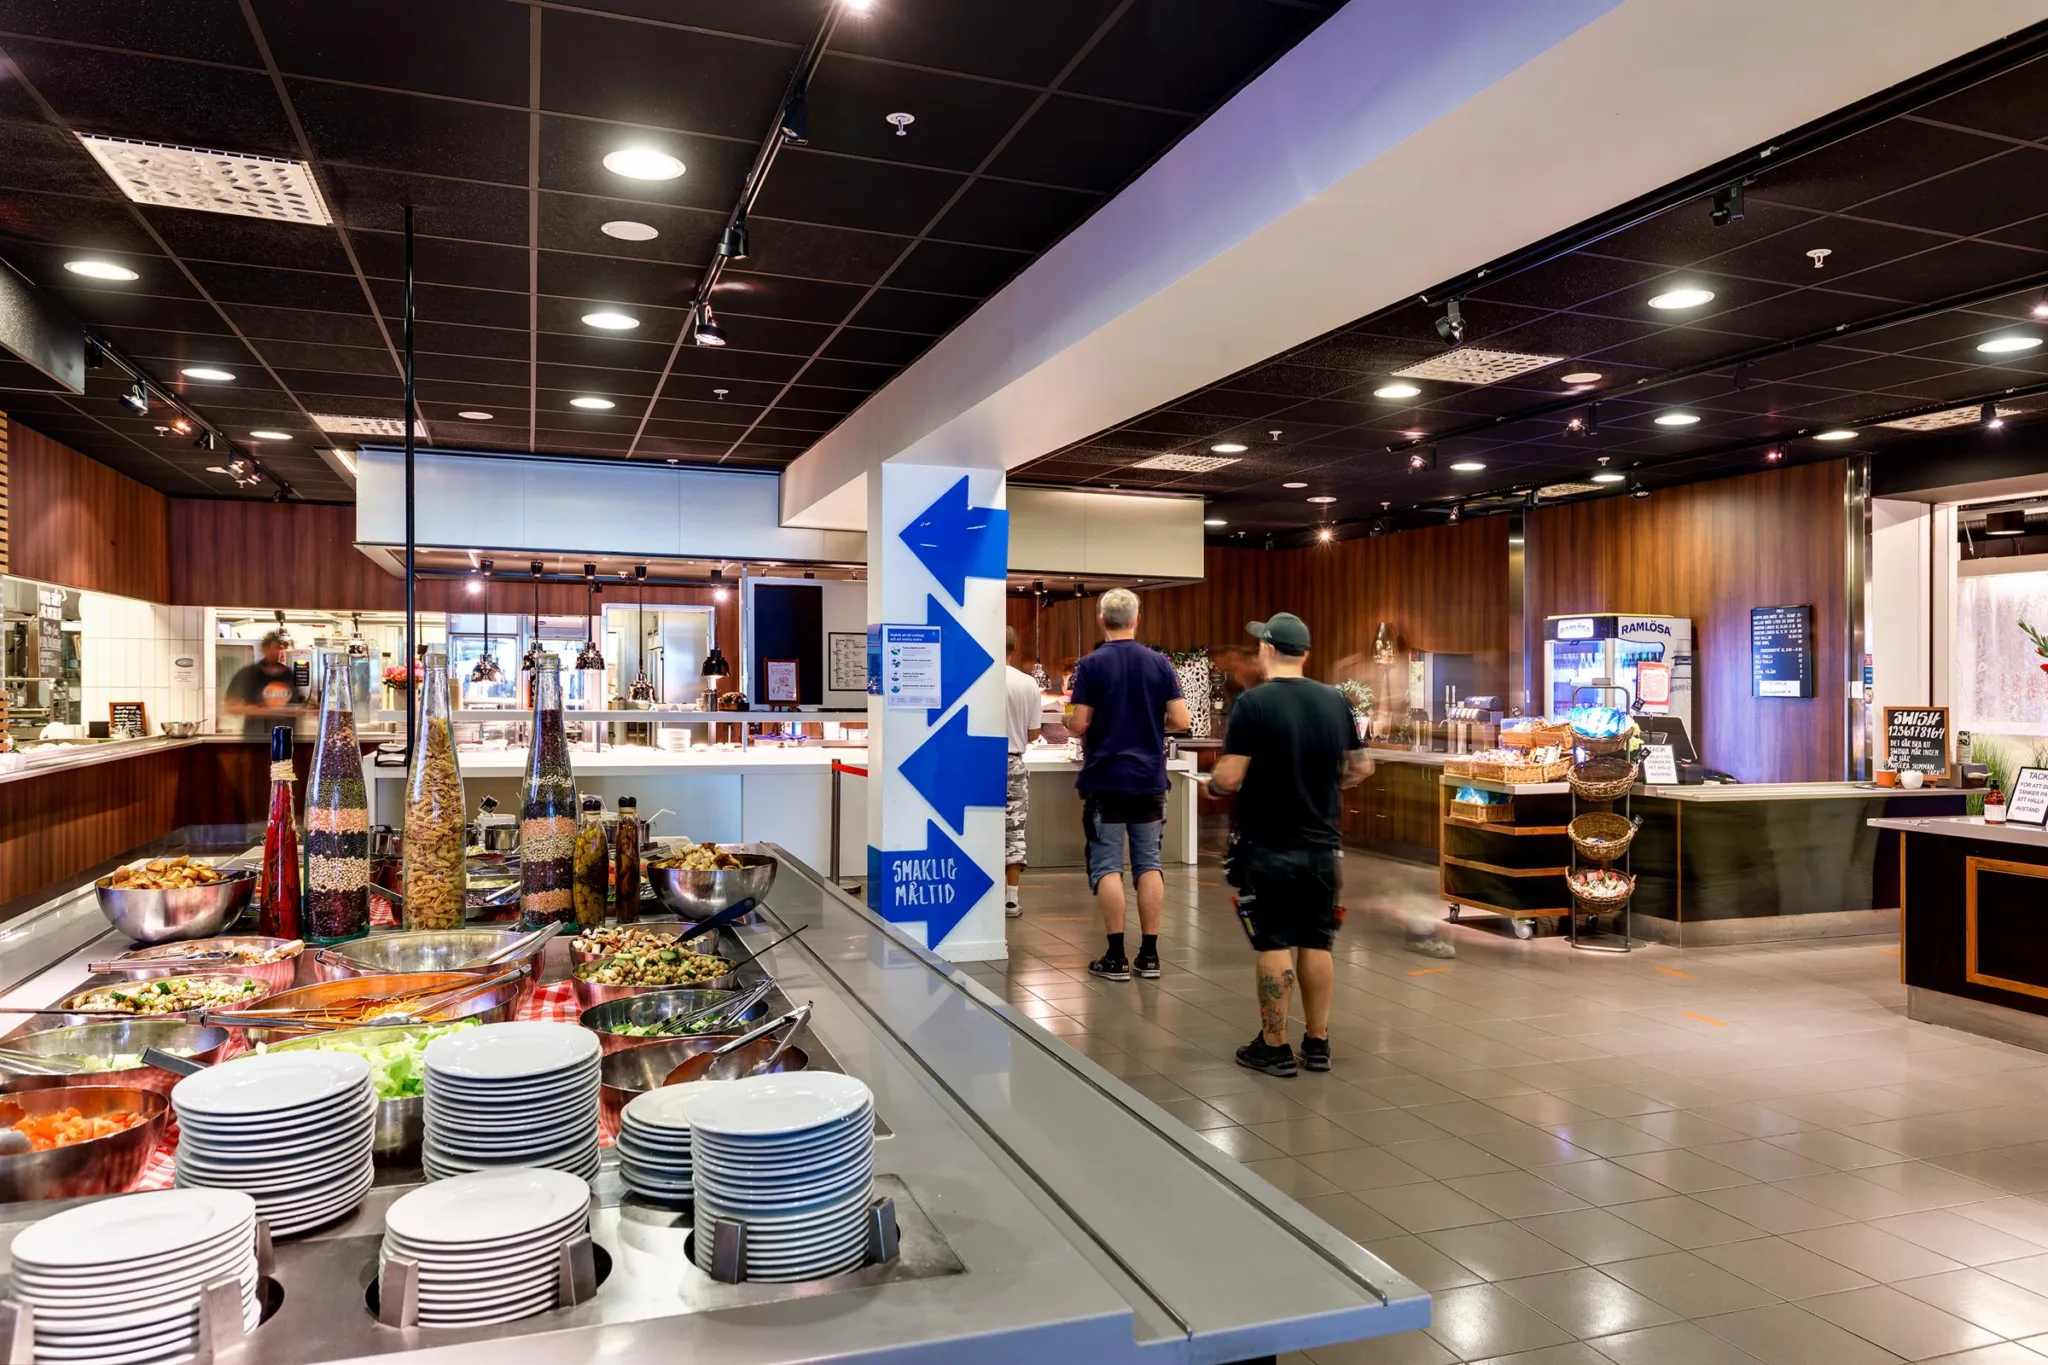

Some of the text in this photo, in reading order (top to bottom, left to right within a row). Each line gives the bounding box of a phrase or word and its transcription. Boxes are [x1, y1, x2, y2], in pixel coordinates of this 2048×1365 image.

[1621, 620, 1672, 637] RAMLÖSA
[1894, 711, 1941, 726] SWISH
[1888, 726, 1945, 739] 1236178164
[1890, 739, 1900, 747] DET
[1911, 740, 1922, 748] BRA
[892, 858, 958, 883] SMAKLIG
[895, 881, 955, 906] MÅLTID
